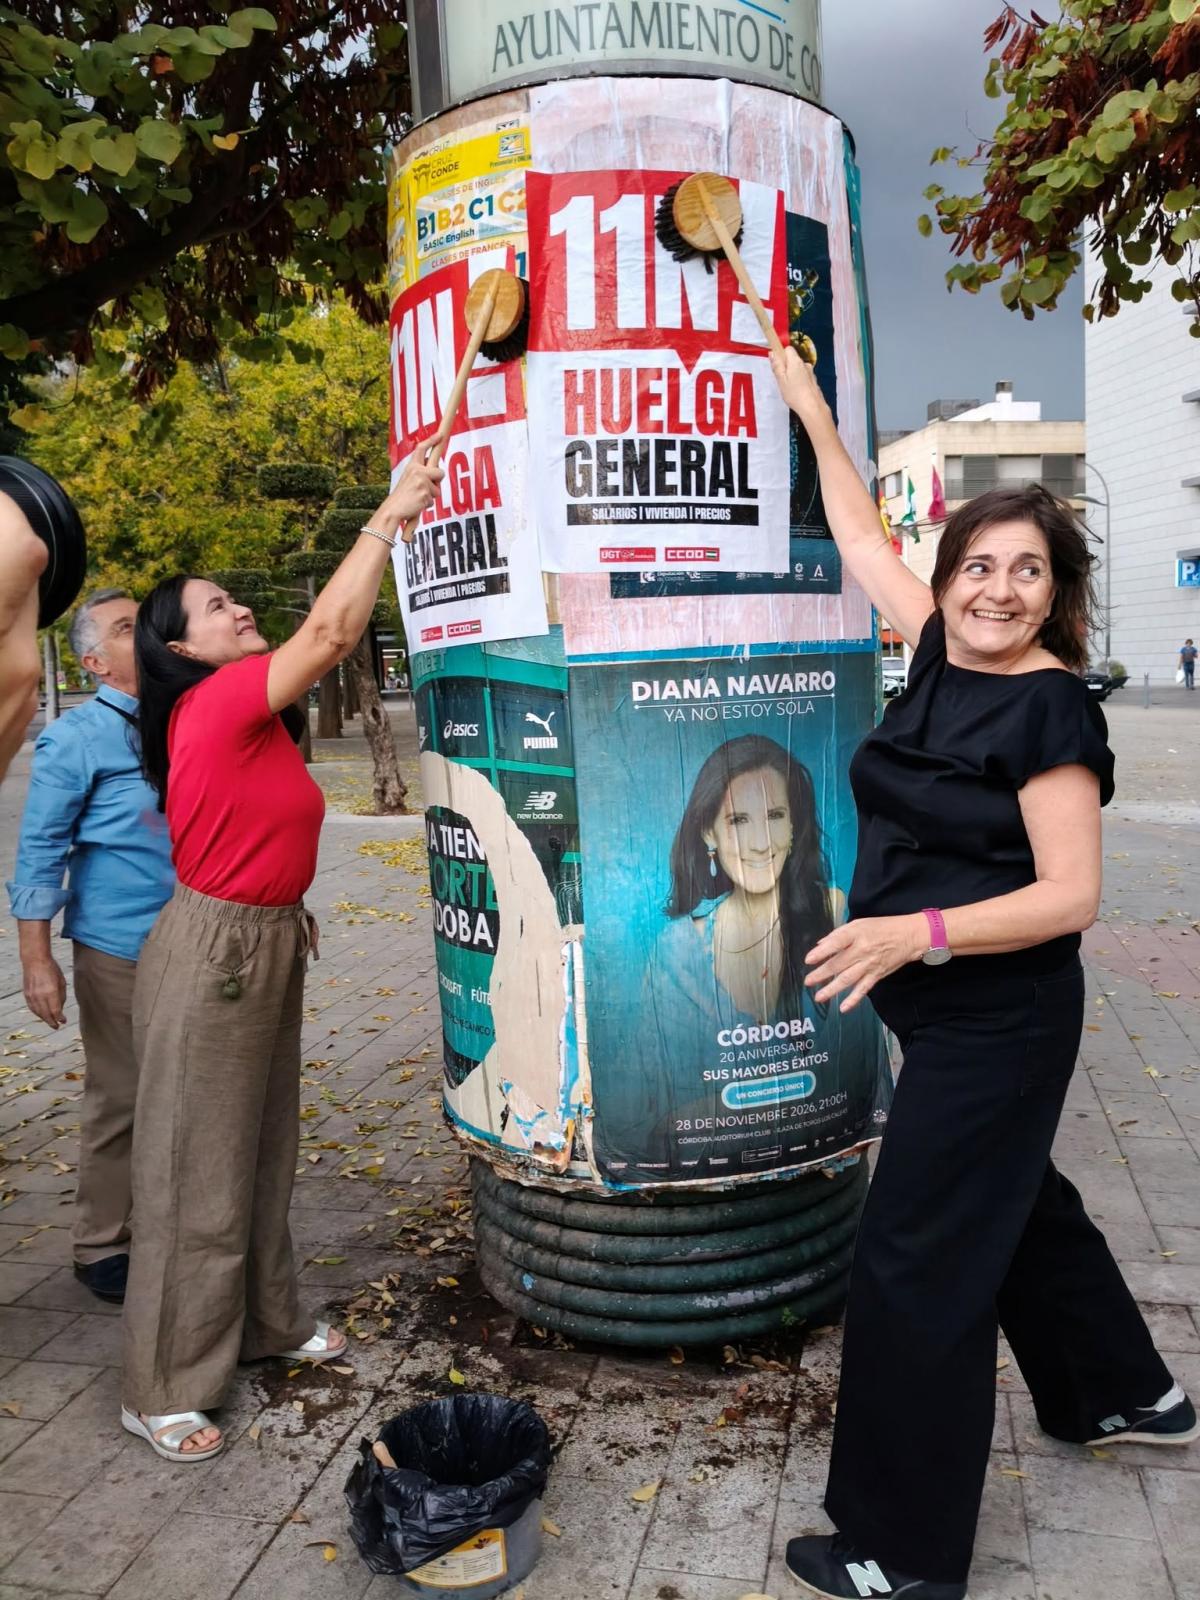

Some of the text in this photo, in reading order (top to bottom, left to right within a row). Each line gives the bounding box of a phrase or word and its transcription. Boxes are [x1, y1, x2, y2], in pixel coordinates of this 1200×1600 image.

[492, 1, 760, 73] AYUNTAMIENTO
[769, 24, 797, 80] DE
[431, 161, 460, 179] CONDE
[462, 184, 473, 193] DE
[417, 212, 435, 240] B1
[438, 203, 465, 231] B2
[468, 195, 494, 220] C1
[424, 236, 443, 252] BASIC
[446, 228, 475, 243] English
[432, 254, 457, 268] CLASES
[459, 250, 470, 259] DE
[563, 367, 758, 438] HUELGA
[565, 439, 758, 499] GENERAL
[592, 506, 731, 521] SALARIOS VIVIENDA PRECIOS
[405, 513, 508, 589] GENERAL
[601, 550, 621, 559] UGT
[667, 550, 704, 559] CCOO
[1182, 562, 1196, 581] P
[632, 670, 836, 701] DIANA NAVARRO
[664, 700, 815, 722] YA NO ESTOY SOLA
[523, 737, 558, 749] PUMA
[532, 812, 563, 820] balance
[717, 1017, 815, 1047] CÓRDOBA
[719, 1039, 815, 1063] 20 ANIVERSARIO
[703, 1052, 829, 1081] SUS MAYORES ÉXITOS
[676, 1120, 691, 1131] 28
[695, 1118, 713, 1129] DE
[716, 1109, 788, 1128] NOVIEMBRE
[790, 1104, 818, 1117] 2026,
[678, 1136, 712, 1145] CÓRDOBA
[845, 1559, 893, 1597] N
